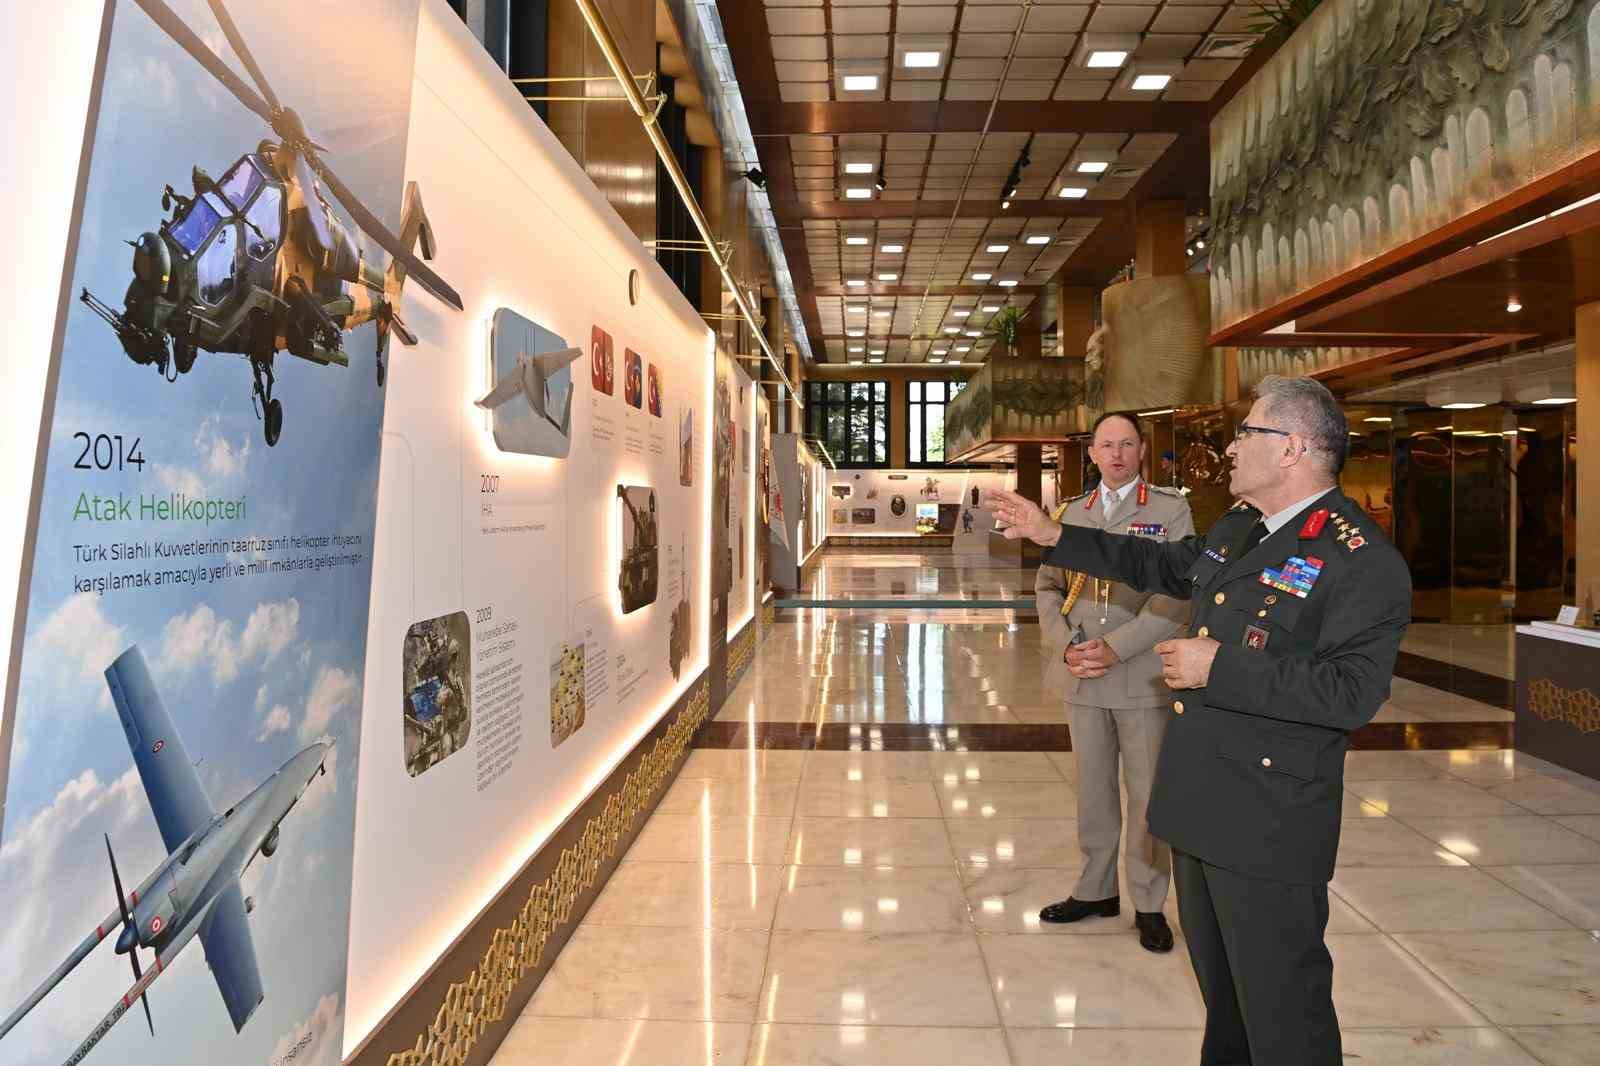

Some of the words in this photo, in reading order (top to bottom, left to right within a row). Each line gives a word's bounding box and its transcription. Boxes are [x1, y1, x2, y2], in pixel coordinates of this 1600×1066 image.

[73, 431, 146, 472] 2014
[73, 491, 132, 521] Atak
[139, 492, 247, 526] Helikopteri
[73, 543, 107, 562] Türk
[111, 541, 151, 561] Silahlı
[154, 538, 229, 558] Kuvvetlerinin
[74, 570, 151, 596] karşılamak
[153, 566, 207, 585] amacıyla
[208, 560, 231, 582] yerli
[233, 563, 246, 576] ve
